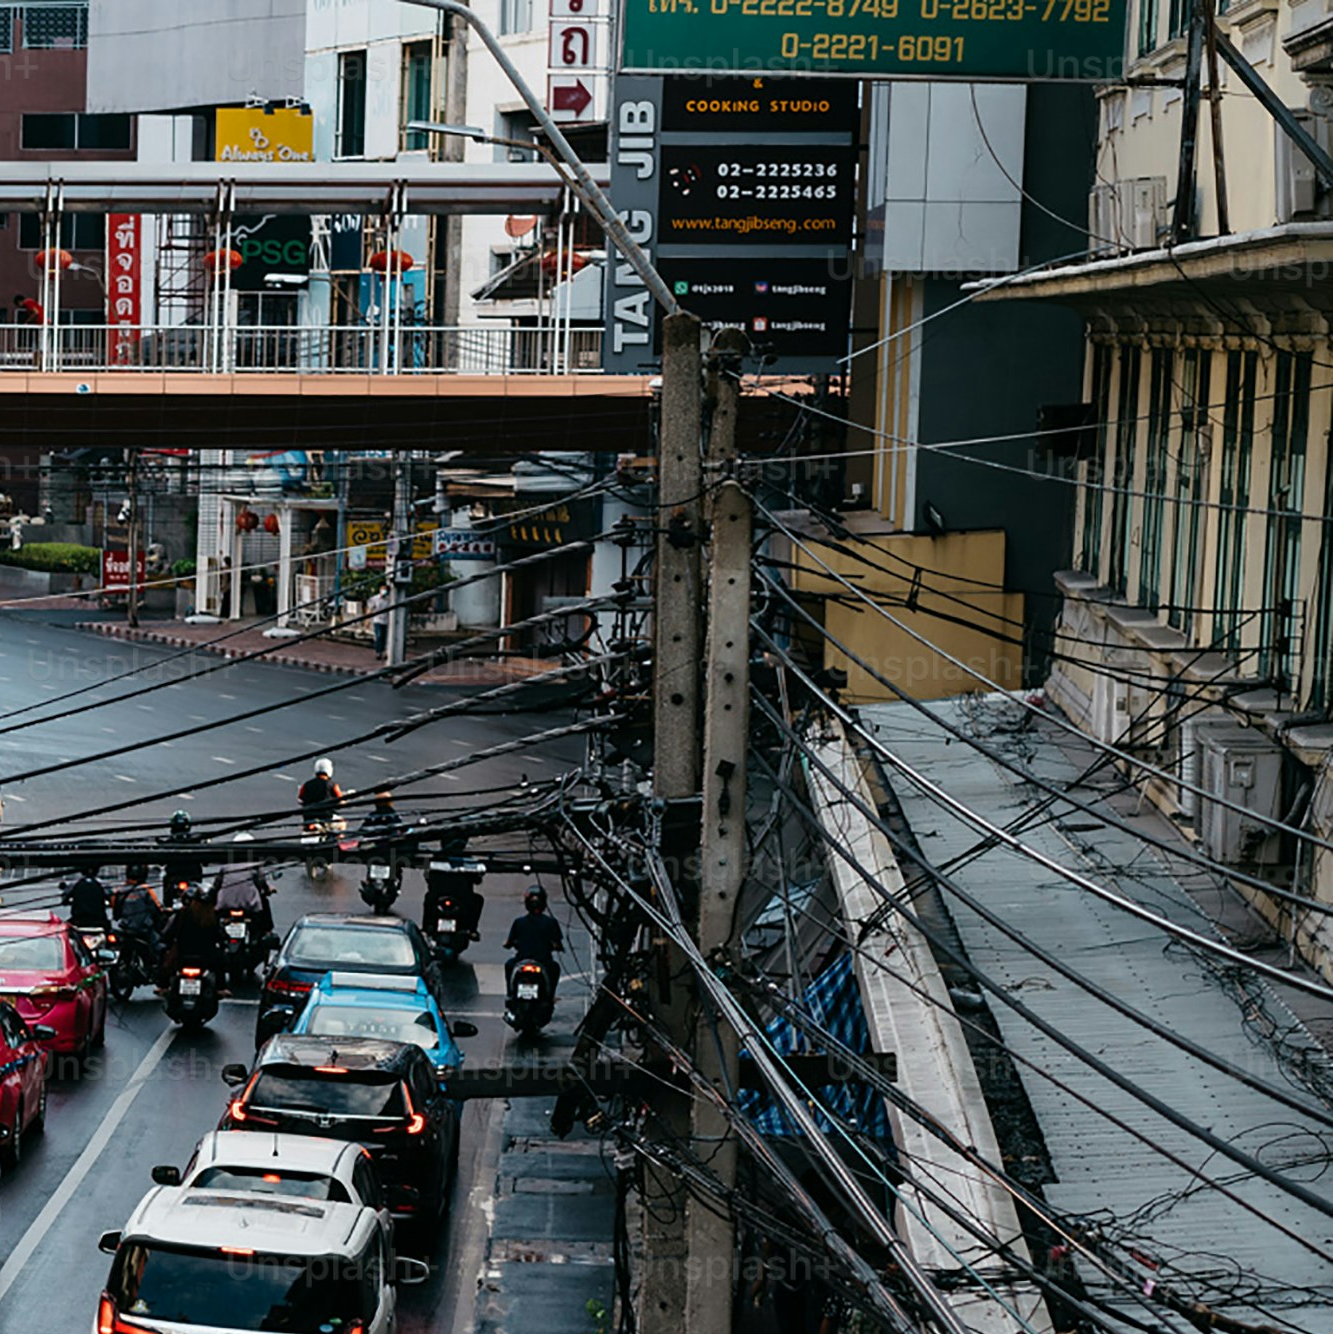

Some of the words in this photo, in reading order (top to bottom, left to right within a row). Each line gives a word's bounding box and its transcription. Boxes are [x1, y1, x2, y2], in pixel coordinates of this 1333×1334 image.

[920, 0, 1111, 22] 0-2623-7792
[781, 33, 965, 62] 0-2221-6091
[617, 100, 656, 180] JIB
[717, 163, 838, 178] 02-2225236
[716, 184, 838, 199] 02-2225465
[671, 216, 837, 235] www.tangjibseng.com
[242, 239, 306, 265] PSG
[612, 209, 654, 353] TANG
